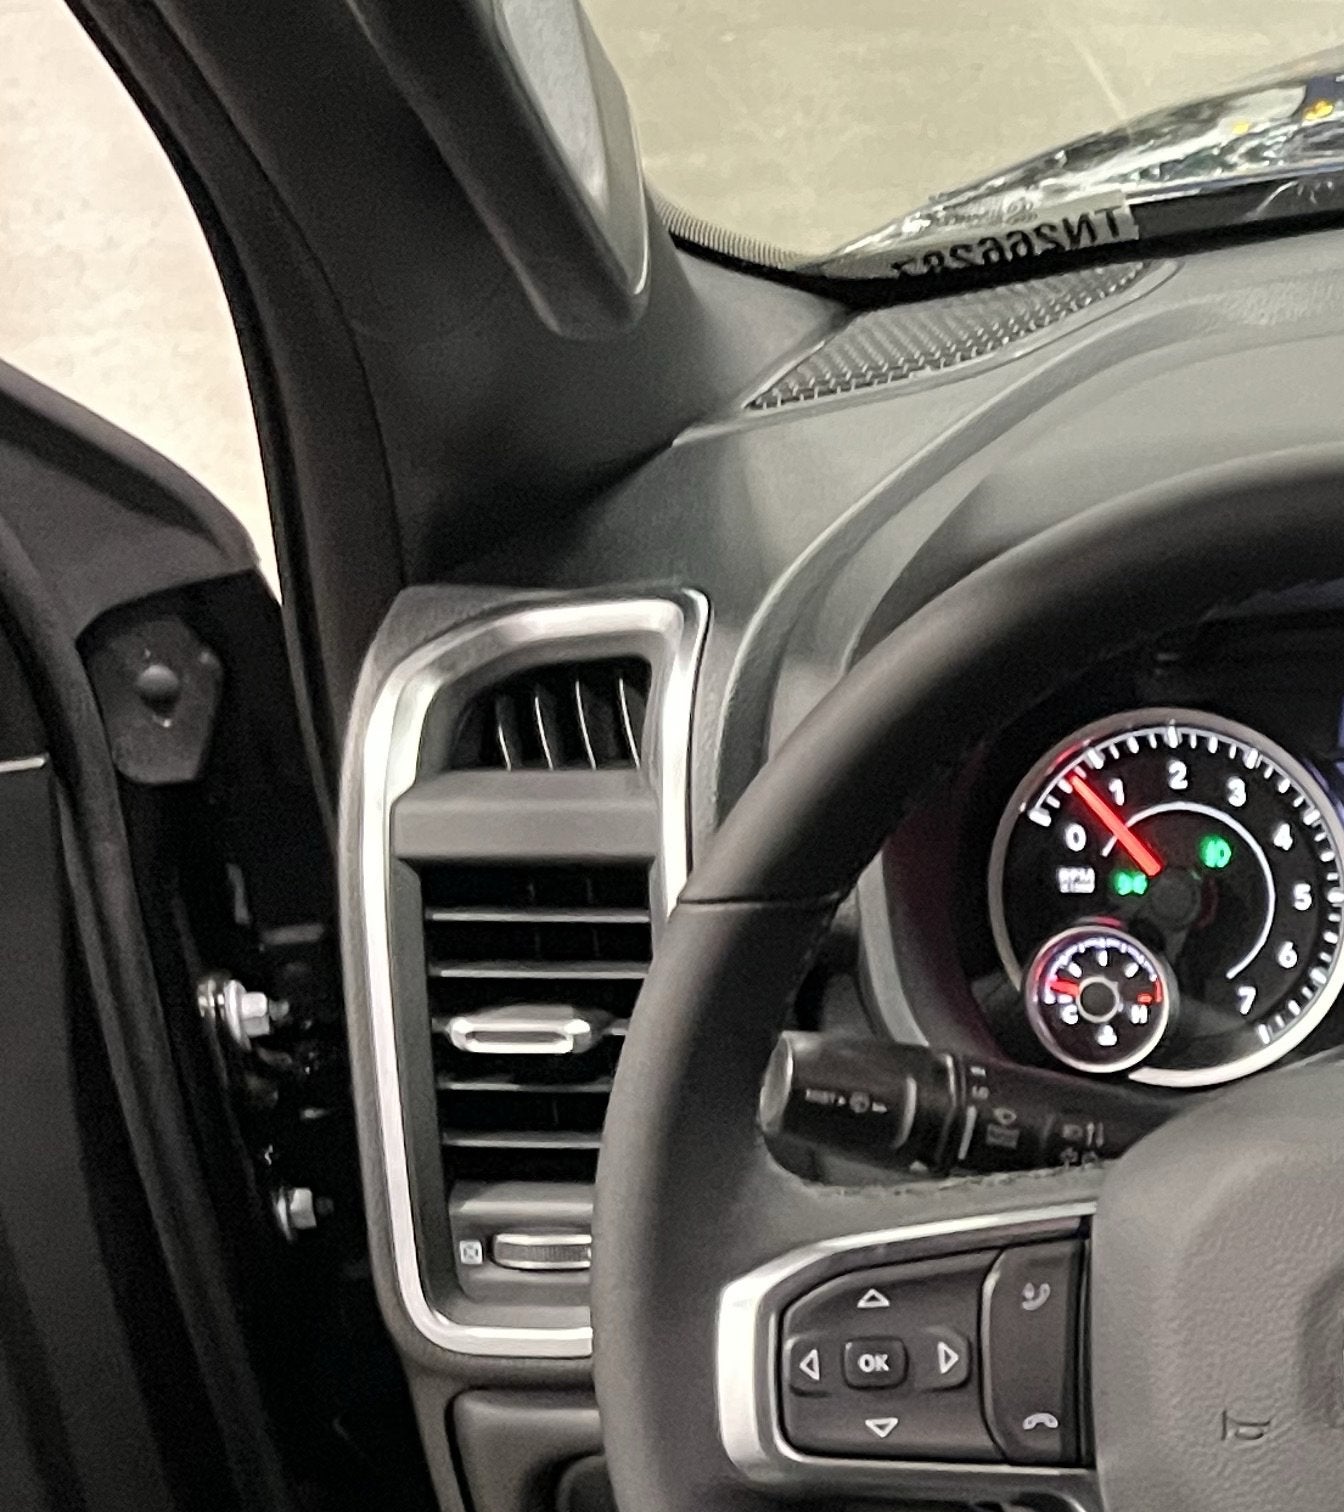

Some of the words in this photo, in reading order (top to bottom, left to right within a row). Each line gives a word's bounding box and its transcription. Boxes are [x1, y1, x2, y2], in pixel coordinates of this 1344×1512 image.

[1168, 760, 1188, 790] 2
[1108, 779, 1125, 806] 1
[1227, 777, 1246, 806] 3
[1065, 823, 1087, 852] 0
[1273, 823, 1293, 851] 4
[1293, 883, 1313, 911] 5
[1277, 941, 1298, 969] 6
[1130, 1004, 1148, 1024] H
[1238, 986, 1256, 1014] 7
[1061, 1004, 1079, 1025] C
[858, 1354, 890, 1373] OK
